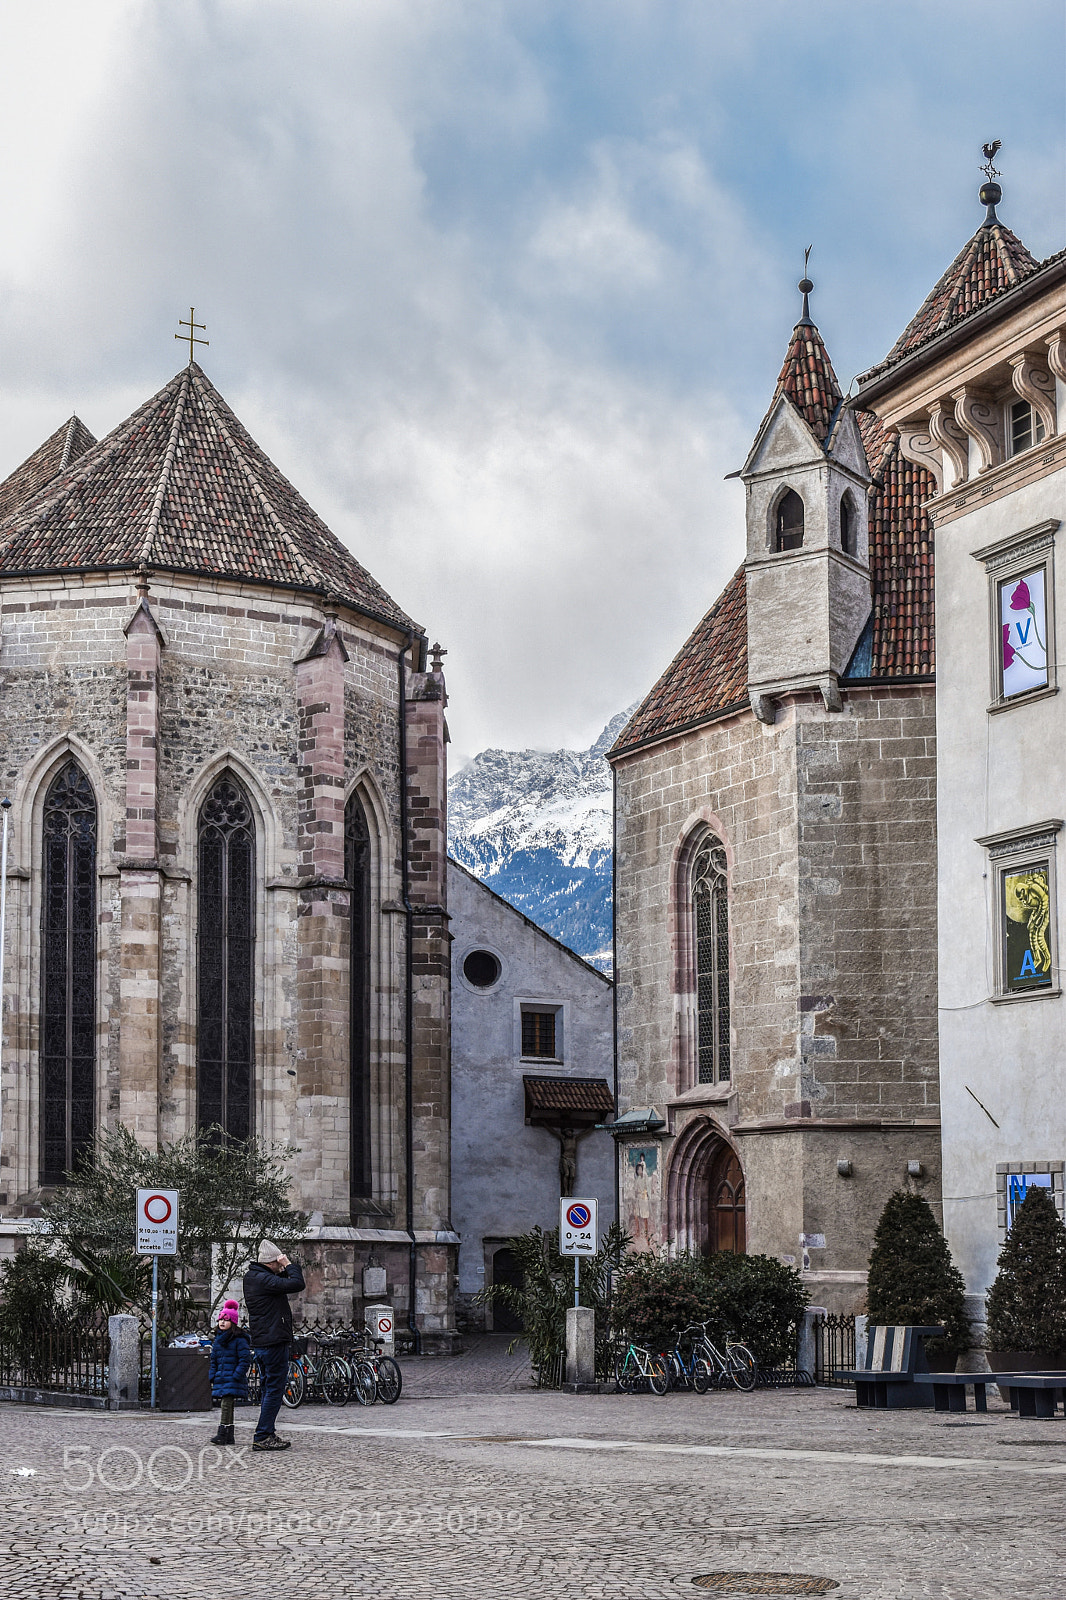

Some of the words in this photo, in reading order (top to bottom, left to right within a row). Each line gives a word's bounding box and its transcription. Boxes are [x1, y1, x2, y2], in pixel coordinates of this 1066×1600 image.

[1016, 618, 1031, 644] V
[1020, 950, 1036, 975] A
[1011, 1175, 1026, 1200] N
